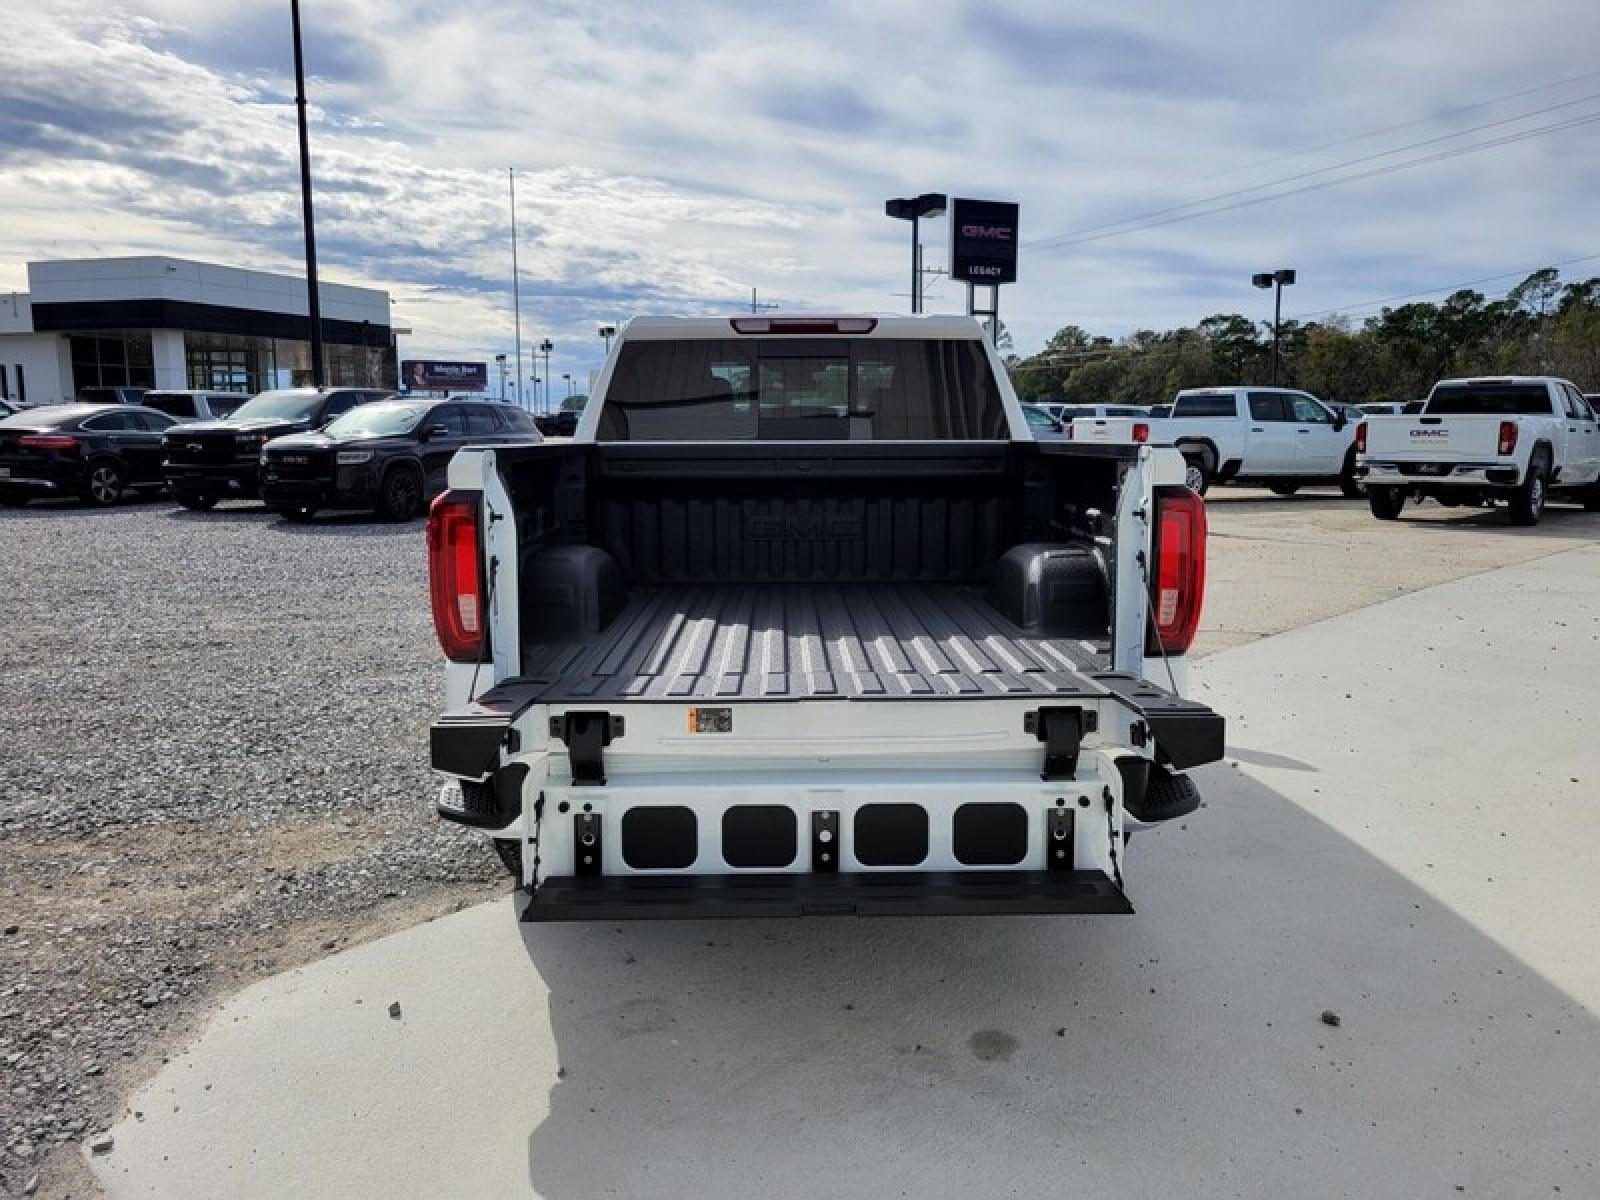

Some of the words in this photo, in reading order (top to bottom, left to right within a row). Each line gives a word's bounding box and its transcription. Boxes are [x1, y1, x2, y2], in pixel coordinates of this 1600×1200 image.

[962, 225, 1011, 239] GMC
[1410, 429, 1449, 438] GMC
[749, 516, 865, 541] GMC
